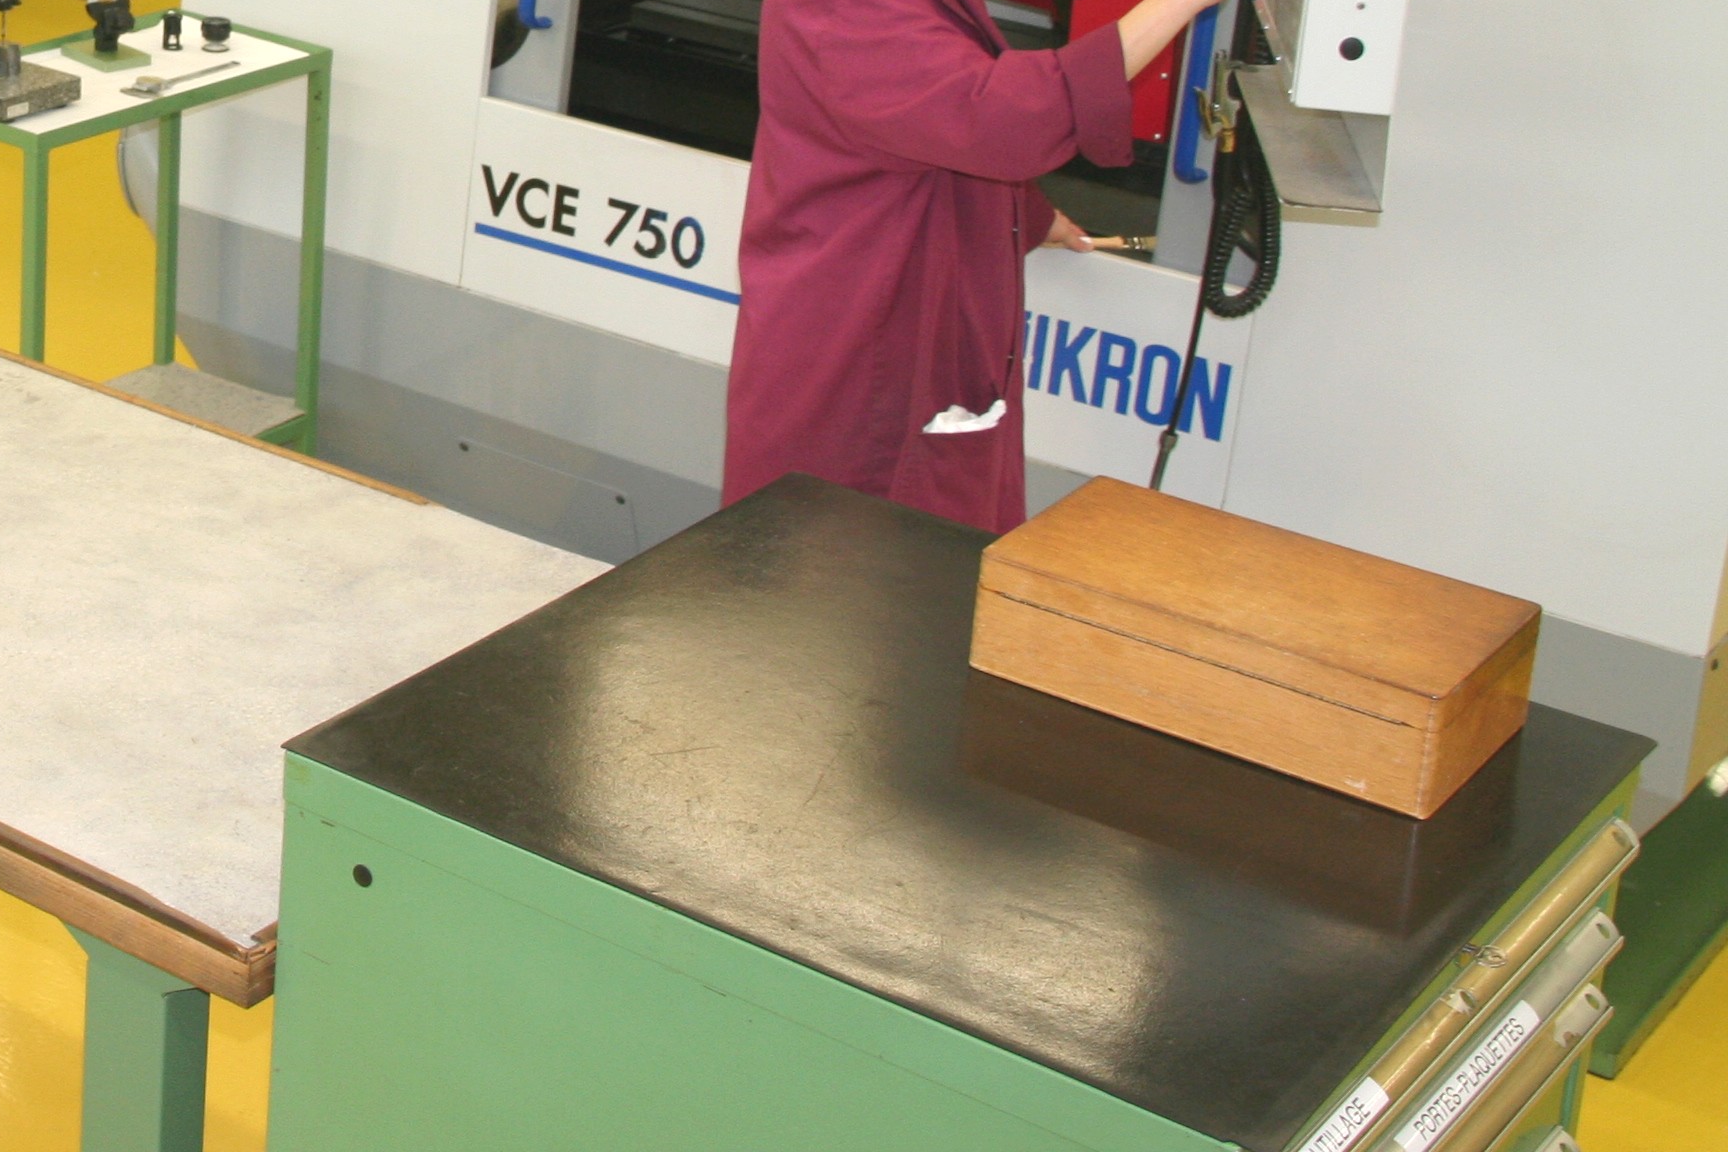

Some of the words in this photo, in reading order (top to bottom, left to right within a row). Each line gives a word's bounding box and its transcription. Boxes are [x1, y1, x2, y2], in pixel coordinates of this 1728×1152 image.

[481, 164, 580, 237] VCE
[604, 197, 705, 269] 750
[1024, 310, 1232, 442] IKRON
[1413, 1017, 1524, 1141] PORTES-PLAQUETTES
